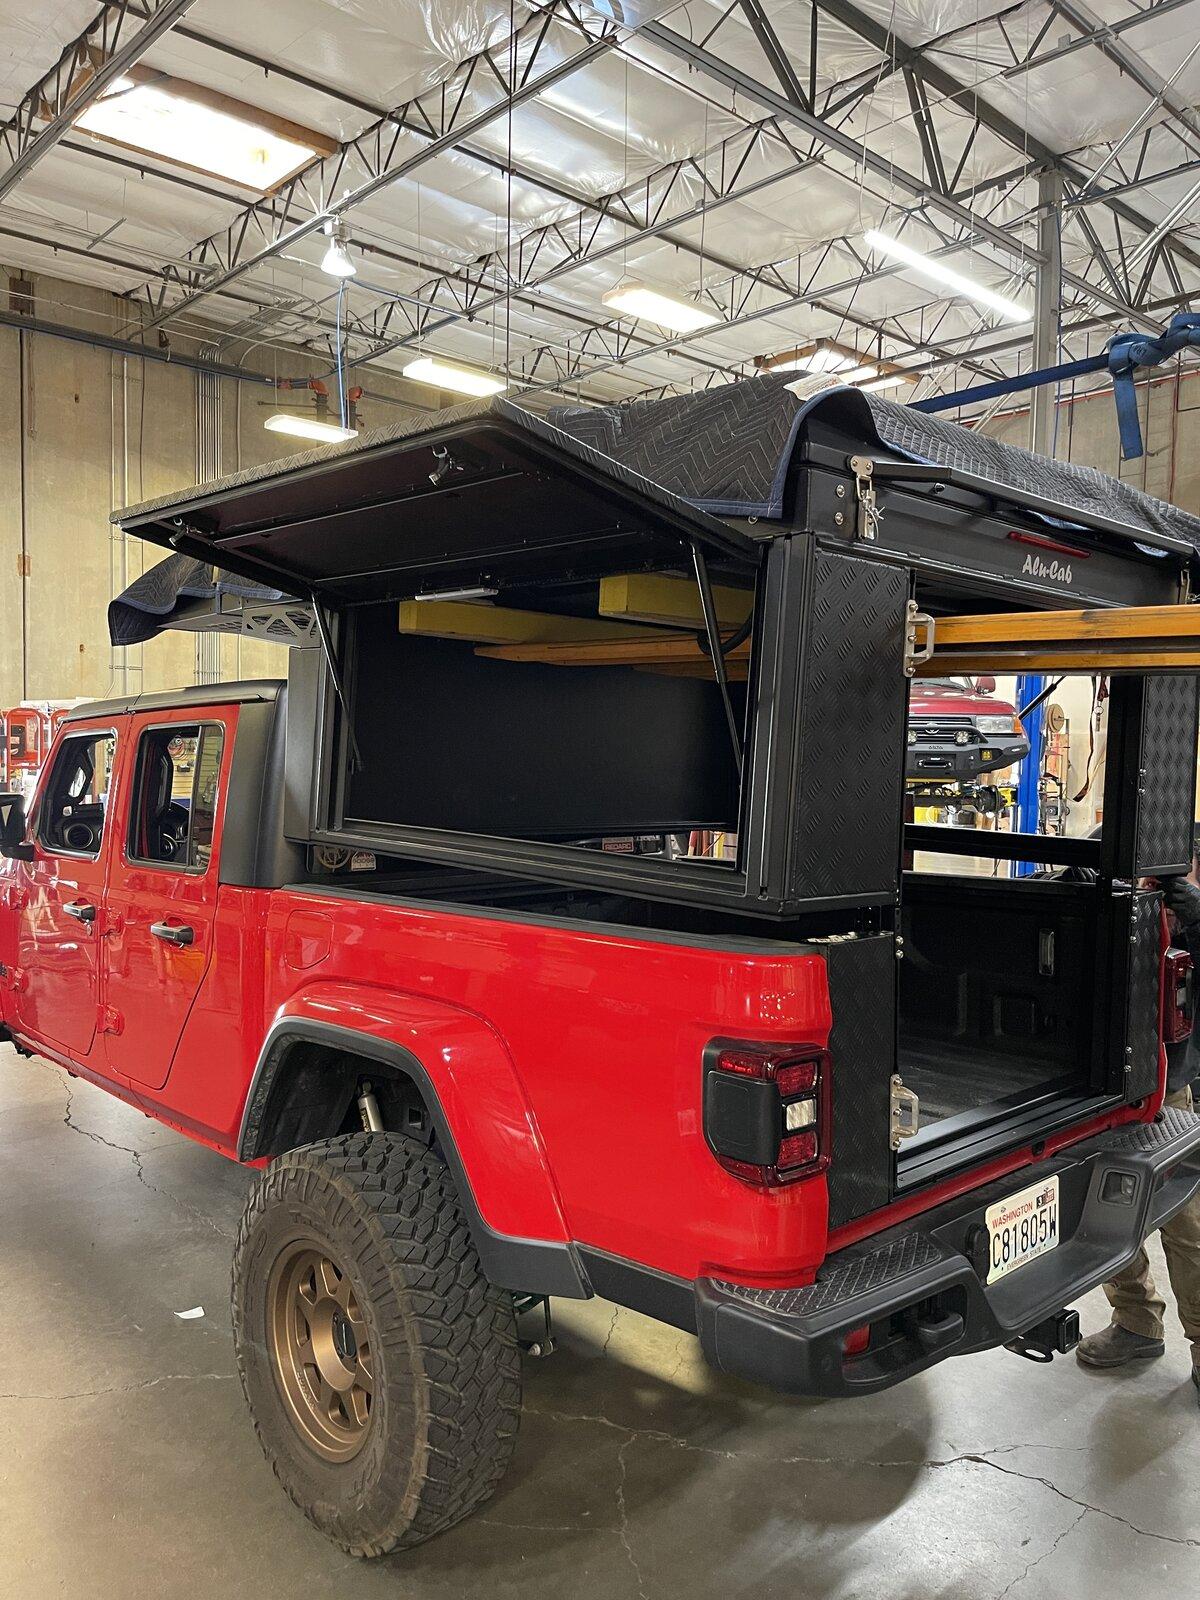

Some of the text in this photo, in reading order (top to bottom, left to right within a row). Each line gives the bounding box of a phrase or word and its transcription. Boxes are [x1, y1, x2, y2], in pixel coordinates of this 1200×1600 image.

[1022, 554, 1073, 584] Alu-Cab
[992, 1201, 1033, 1229] WASHINGTON
[993, 1203, 1057, 1269] C81805W
